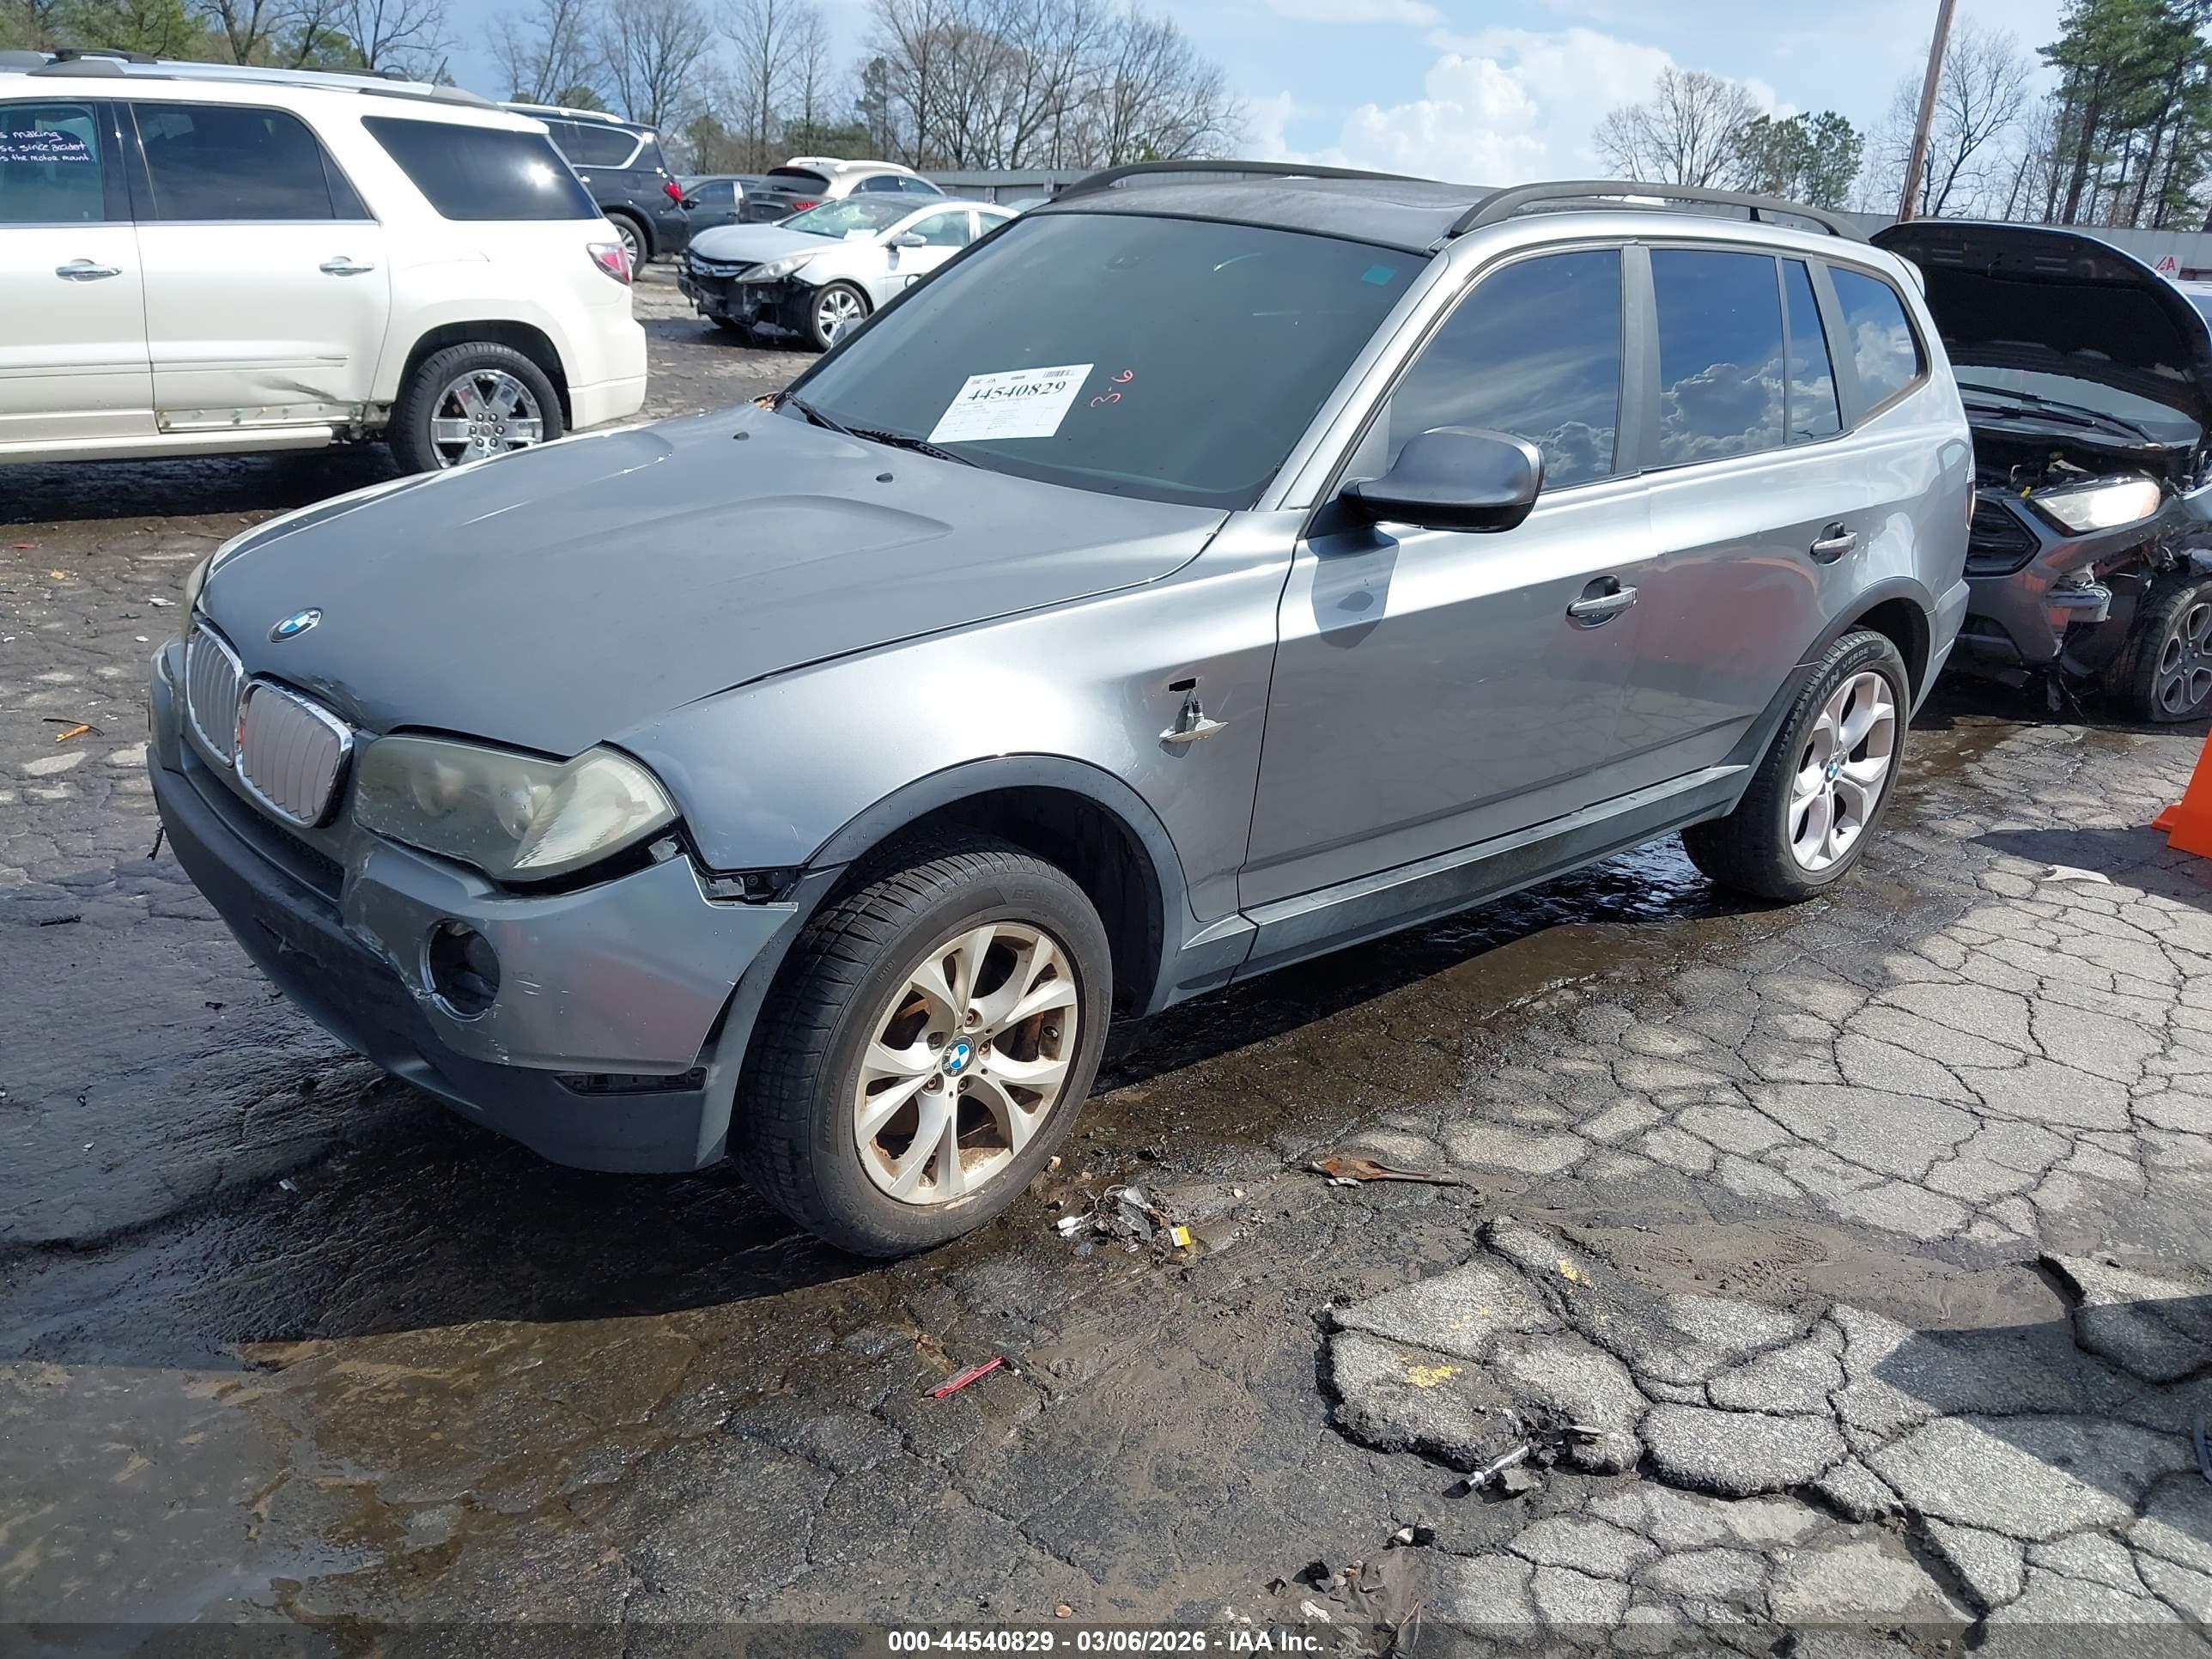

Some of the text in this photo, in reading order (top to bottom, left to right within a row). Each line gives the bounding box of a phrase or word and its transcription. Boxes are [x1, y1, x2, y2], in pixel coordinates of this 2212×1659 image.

[13, 131, 63, 144] making
[969, 380, 1066, 401] 44540829
[1842, 647, 1869, 669] VERDE
